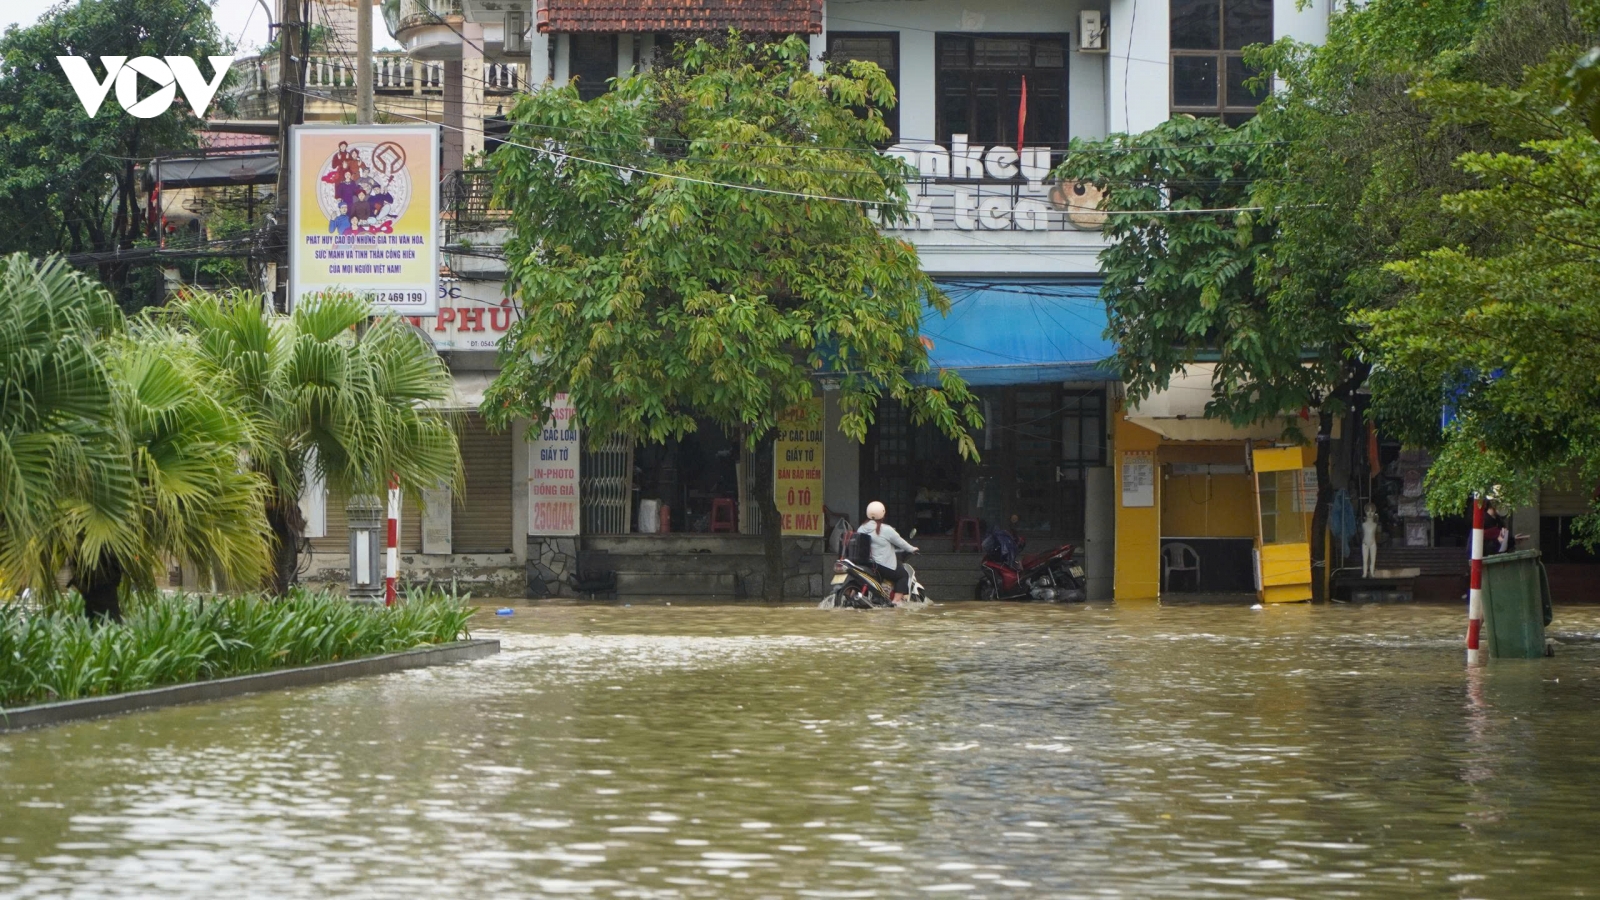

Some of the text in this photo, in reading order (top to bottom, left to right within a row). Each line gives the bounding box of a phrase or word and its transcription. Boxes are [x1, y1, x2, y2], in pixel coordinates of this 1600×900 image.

[954, 189, 1048, 231] tea
[321, 235, 333, 245] HUY
[334, 235, 346, 245] CAO
[386, 264, 402, 274] NAM!
[387, 292, 404, 303] 469
[406, 292, 422, 303] 199
[435, 298, 512, 332] PHÚ
[543, 426, 559, 441] CÁC
[560, 429, 577, 444] LOẠI
[789, 426, 804, 442] CÁC
[806, 430, 823, 445] LOẠI
[540, 444, 569, 461] GIẤY TỜ
[785, 445, 814, 462] GIẤY TỜ
[534, 468, 575, 479] IN-PHOTO
[777, 466, 791, 480] BÁN
[559, 482, 575, 496] GIÁ
[787, 486, 811, 506] Ô TÔ
[795, 510, 819, 531] MÁY
